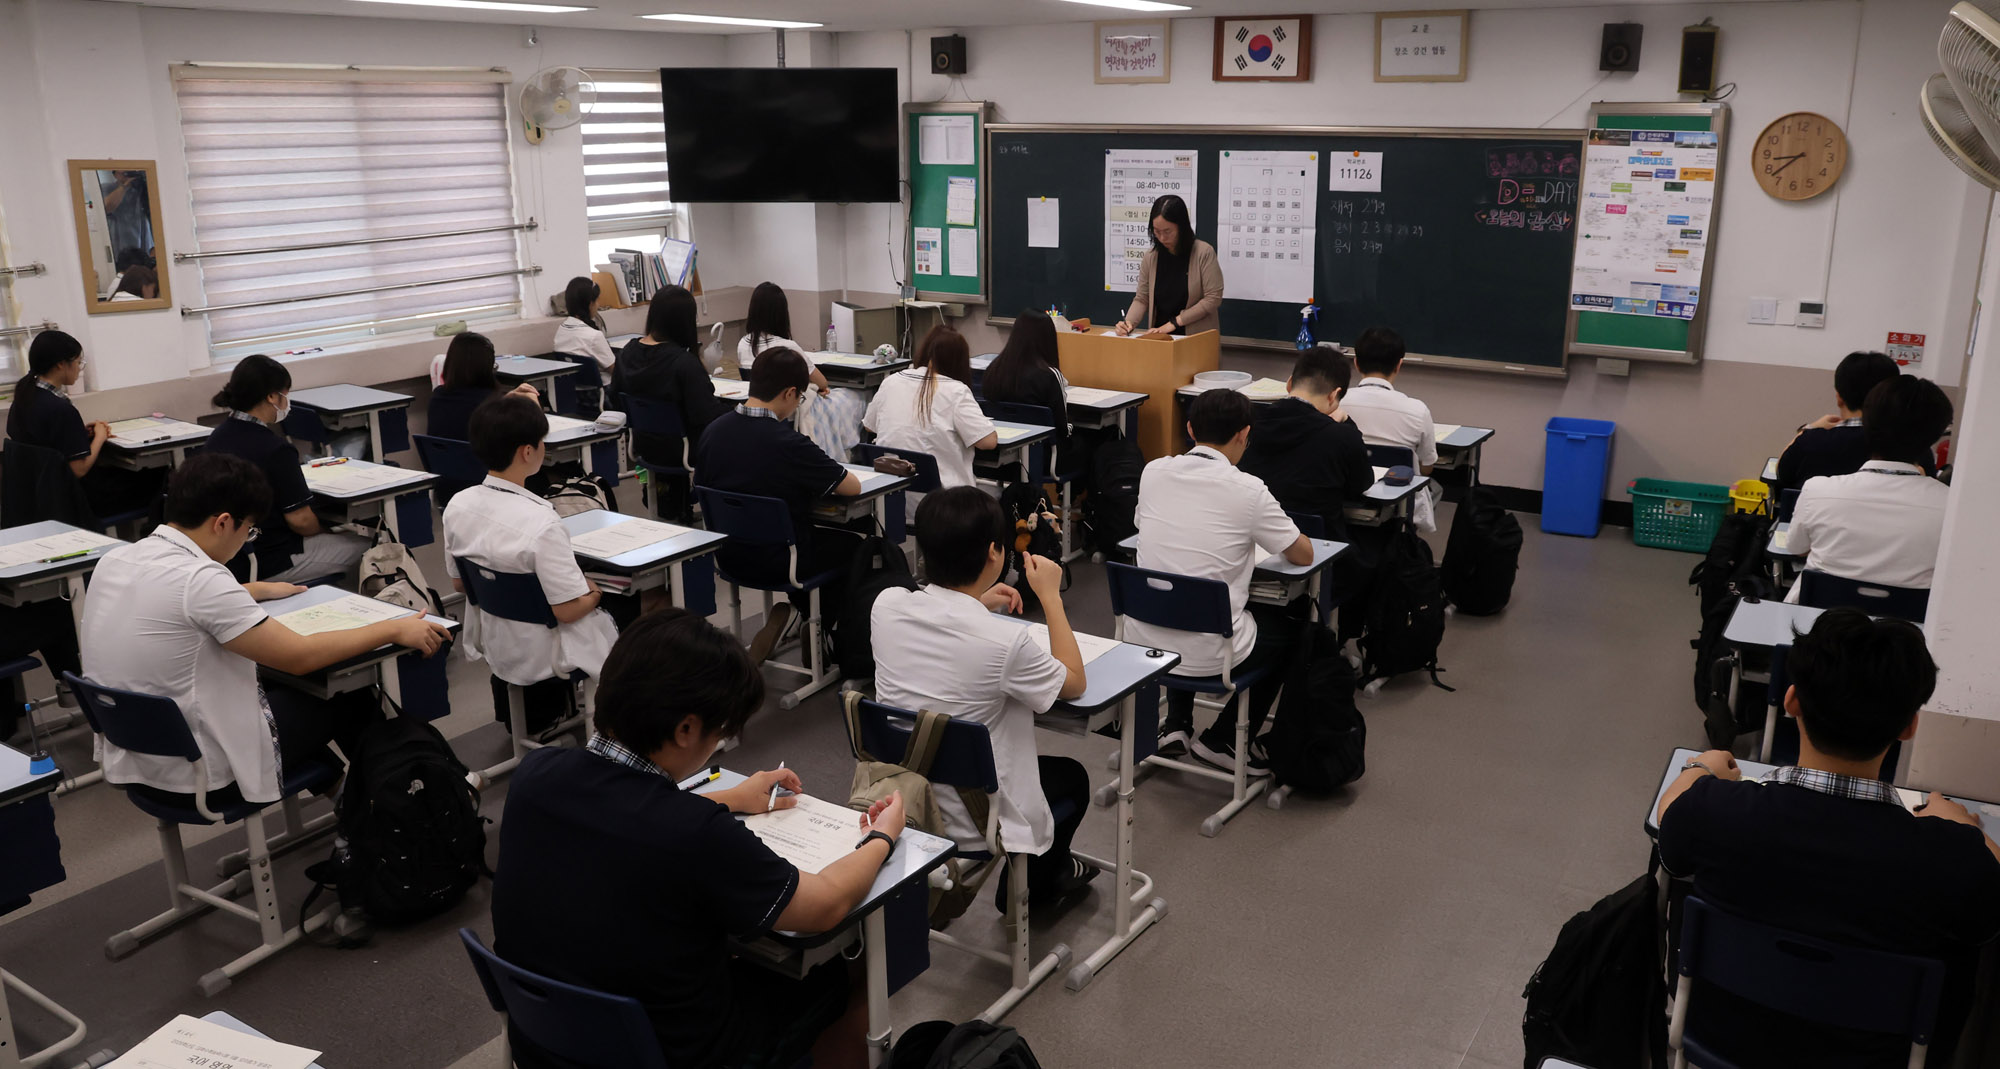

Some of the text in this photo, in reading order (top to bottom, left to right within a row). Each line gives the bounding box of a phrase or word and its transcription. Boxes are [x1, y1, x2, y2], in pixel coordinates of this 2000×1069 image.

[1782, 125, 1791, 135] 11
[1798, 121, 1810, 132] 12
[1816, 126, 1821, 136] 1
[1768, 135, 1779, 145] 10
[1824, 138, 1833, 148] 2
[1763, 149, 1771, 160] 9
[1826, 153, 1834, 163] 3
[1341, 169, 1372, 179] 11126
[1765, 164, 1772, 174] 8
[1819, 168, 1827, 177] 4
[1136, 182, 1180, 190] 08:40~10:00
[1775, 176, 1782, 186] 7
[1790, 181, 1798, 191] 6
[1806, 178, 1814, 188] 5
[1137, 196, 1156, 204] 10:30
[1486, 209, 1526, 228] 오늘의
[1126, 224, 1149, 233] 13:10~
[187, 1054, 210, 1066] 국어
